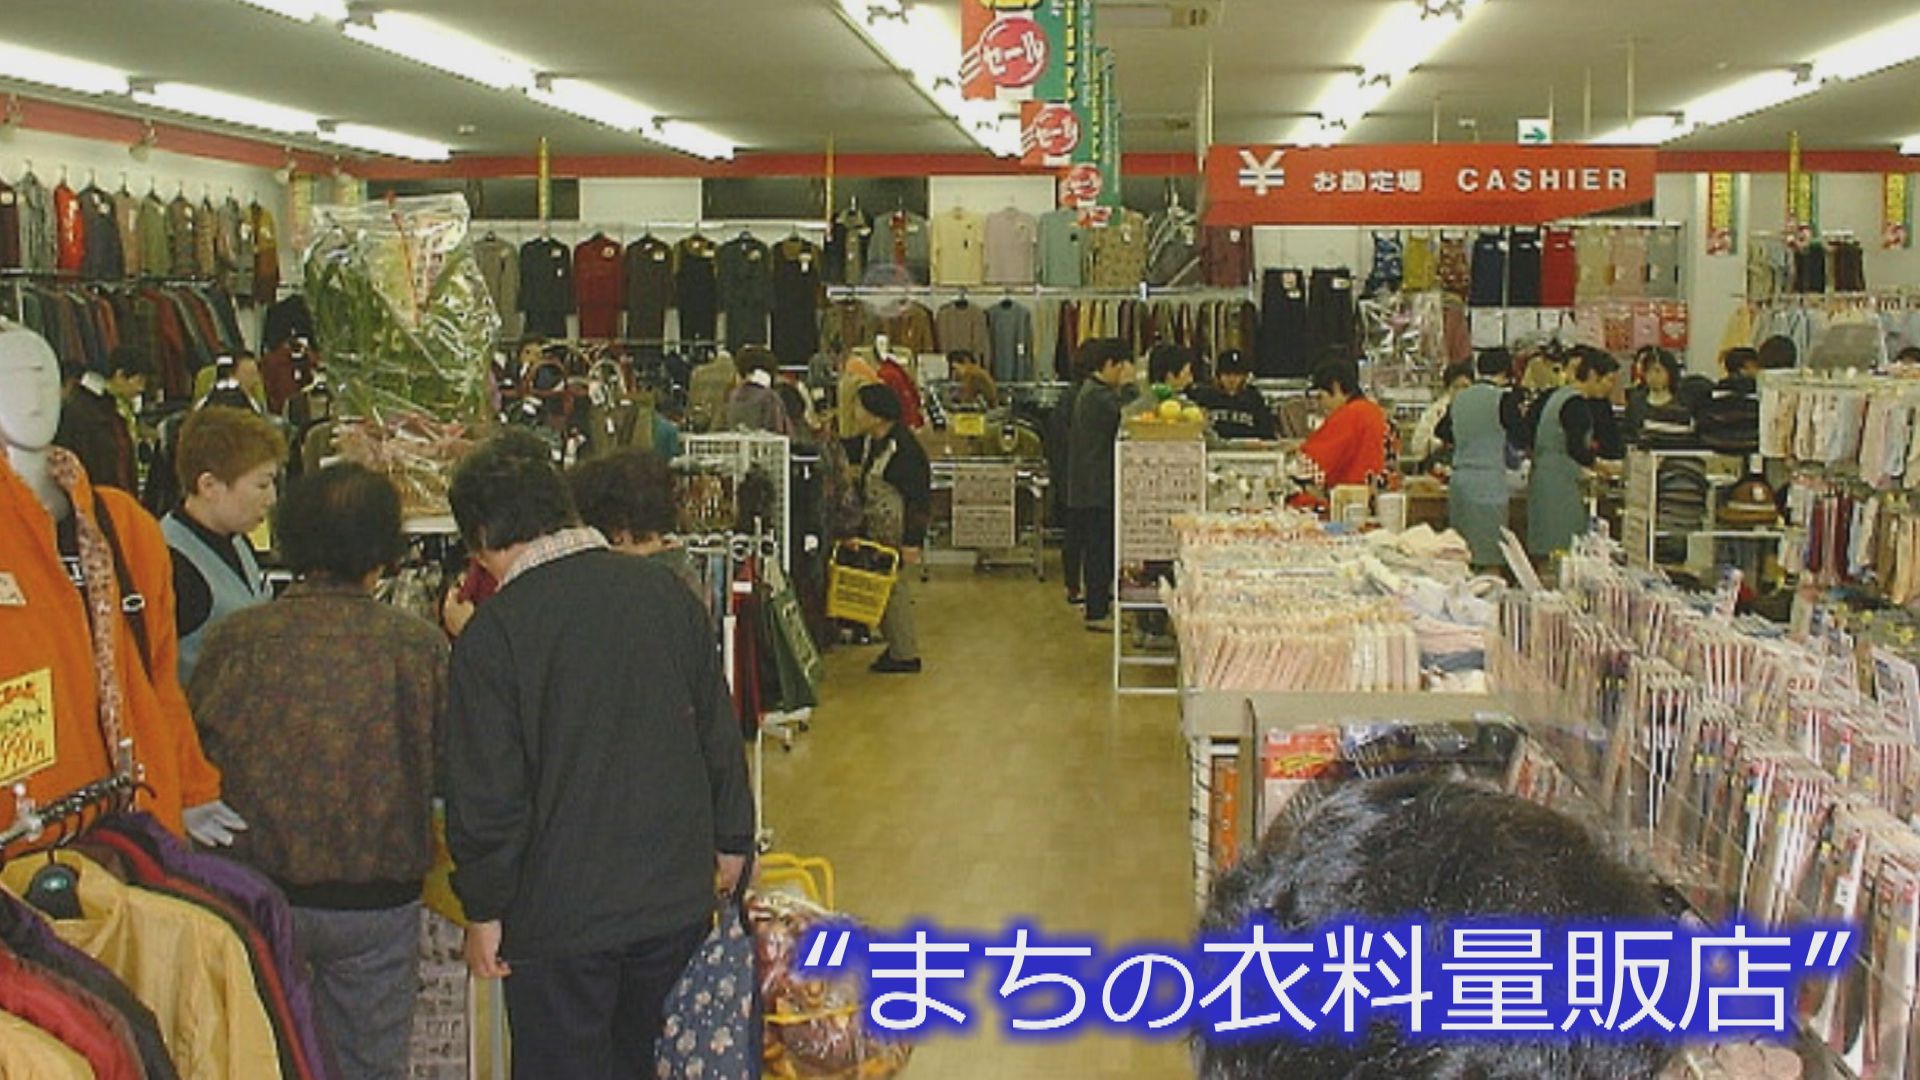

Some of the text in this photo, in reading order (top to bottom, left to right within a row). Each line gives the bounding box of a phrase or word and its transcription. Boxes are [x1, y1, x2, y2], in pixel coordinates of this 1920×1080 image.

[982, 31, 1045, 75] セール
[1238, 149, 1627, 196] ¥ お勘定場 CASHIER
